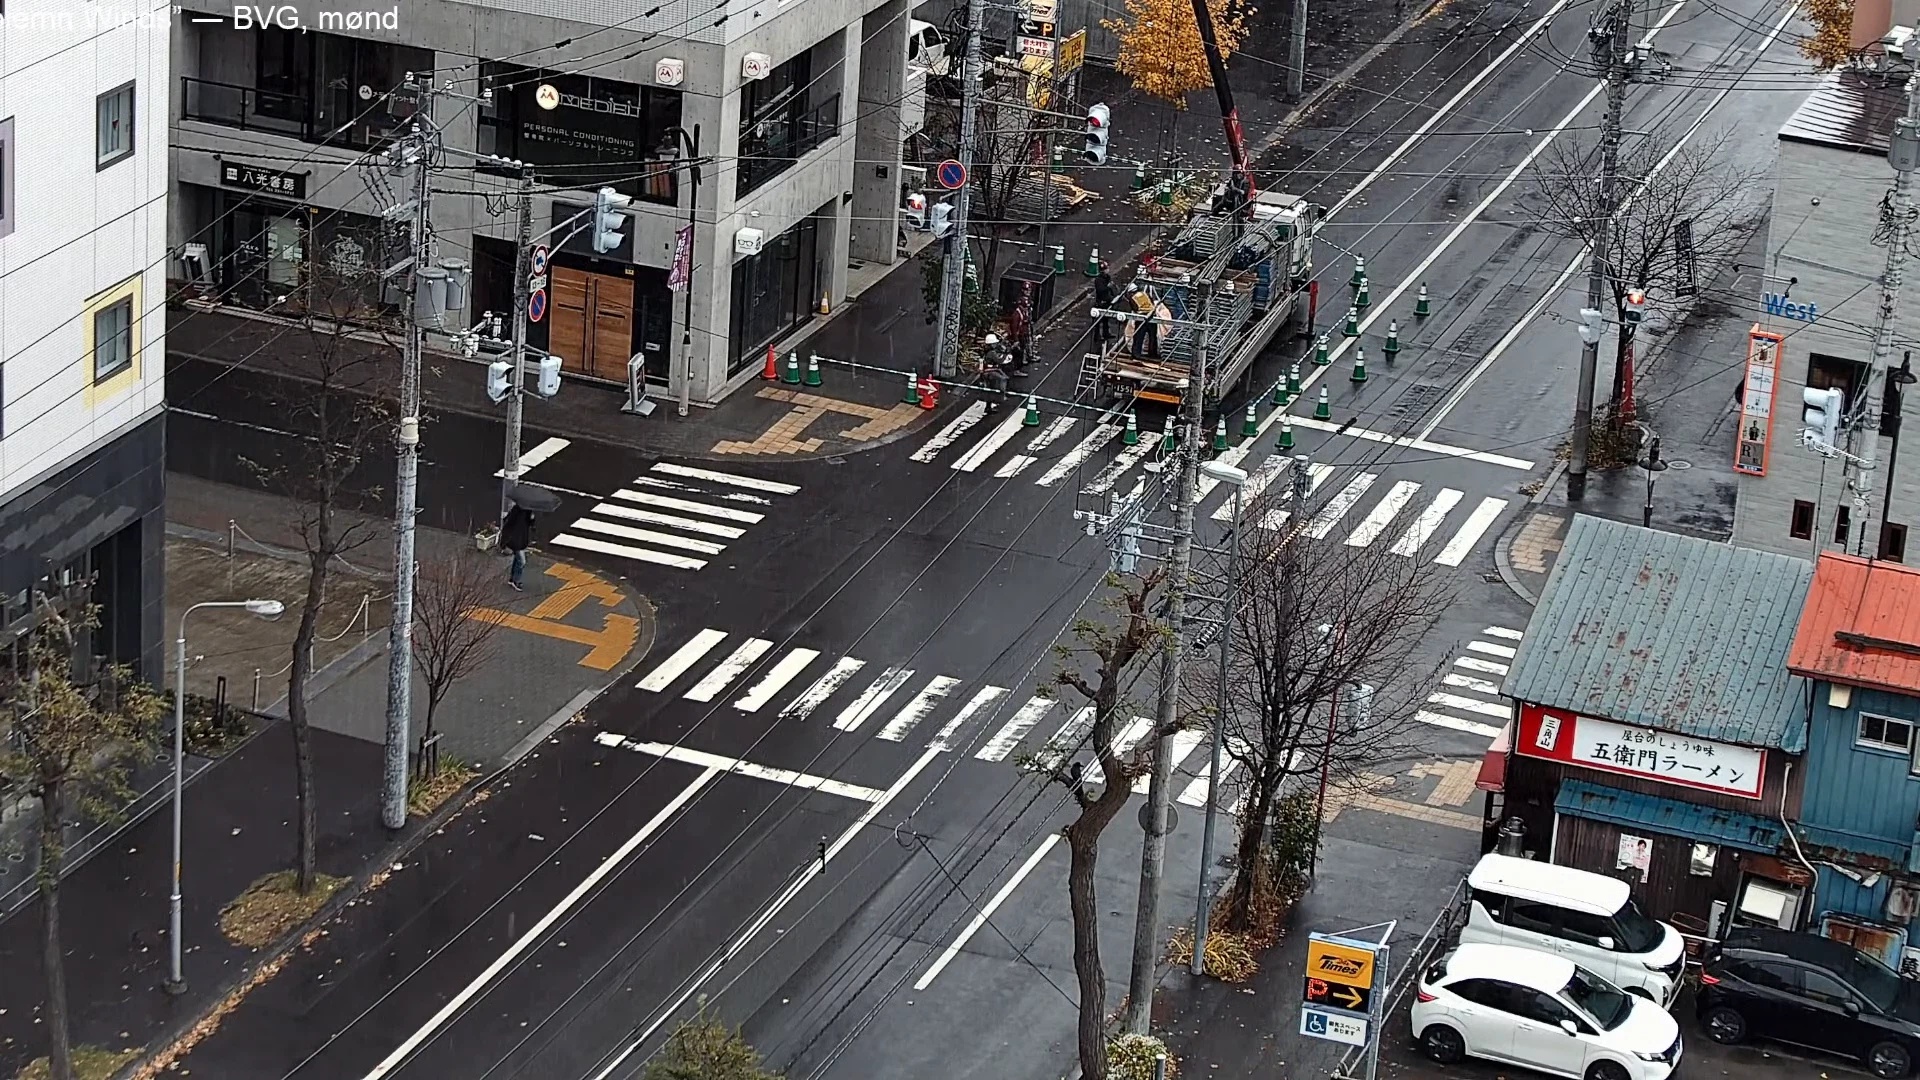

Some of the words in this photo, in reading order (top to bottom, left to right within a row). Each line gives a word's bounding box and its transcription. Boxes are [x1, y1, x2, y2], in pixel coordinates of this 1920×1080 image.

[1043, 23, 1053, 36] P
[524, 122, 570, 136] PERSONAL
[573, 131, 635, 147] CONDITIONING
[1765, 291, 1817, 321] West
[1621, 729, 1715, 757] 屋台のしょうゆ味
[1590, 742, 1745, 784] 五衛門ラーメン
[1320, 959, 1359, 975] Times
[1308, 979, 1328, 1000] P
